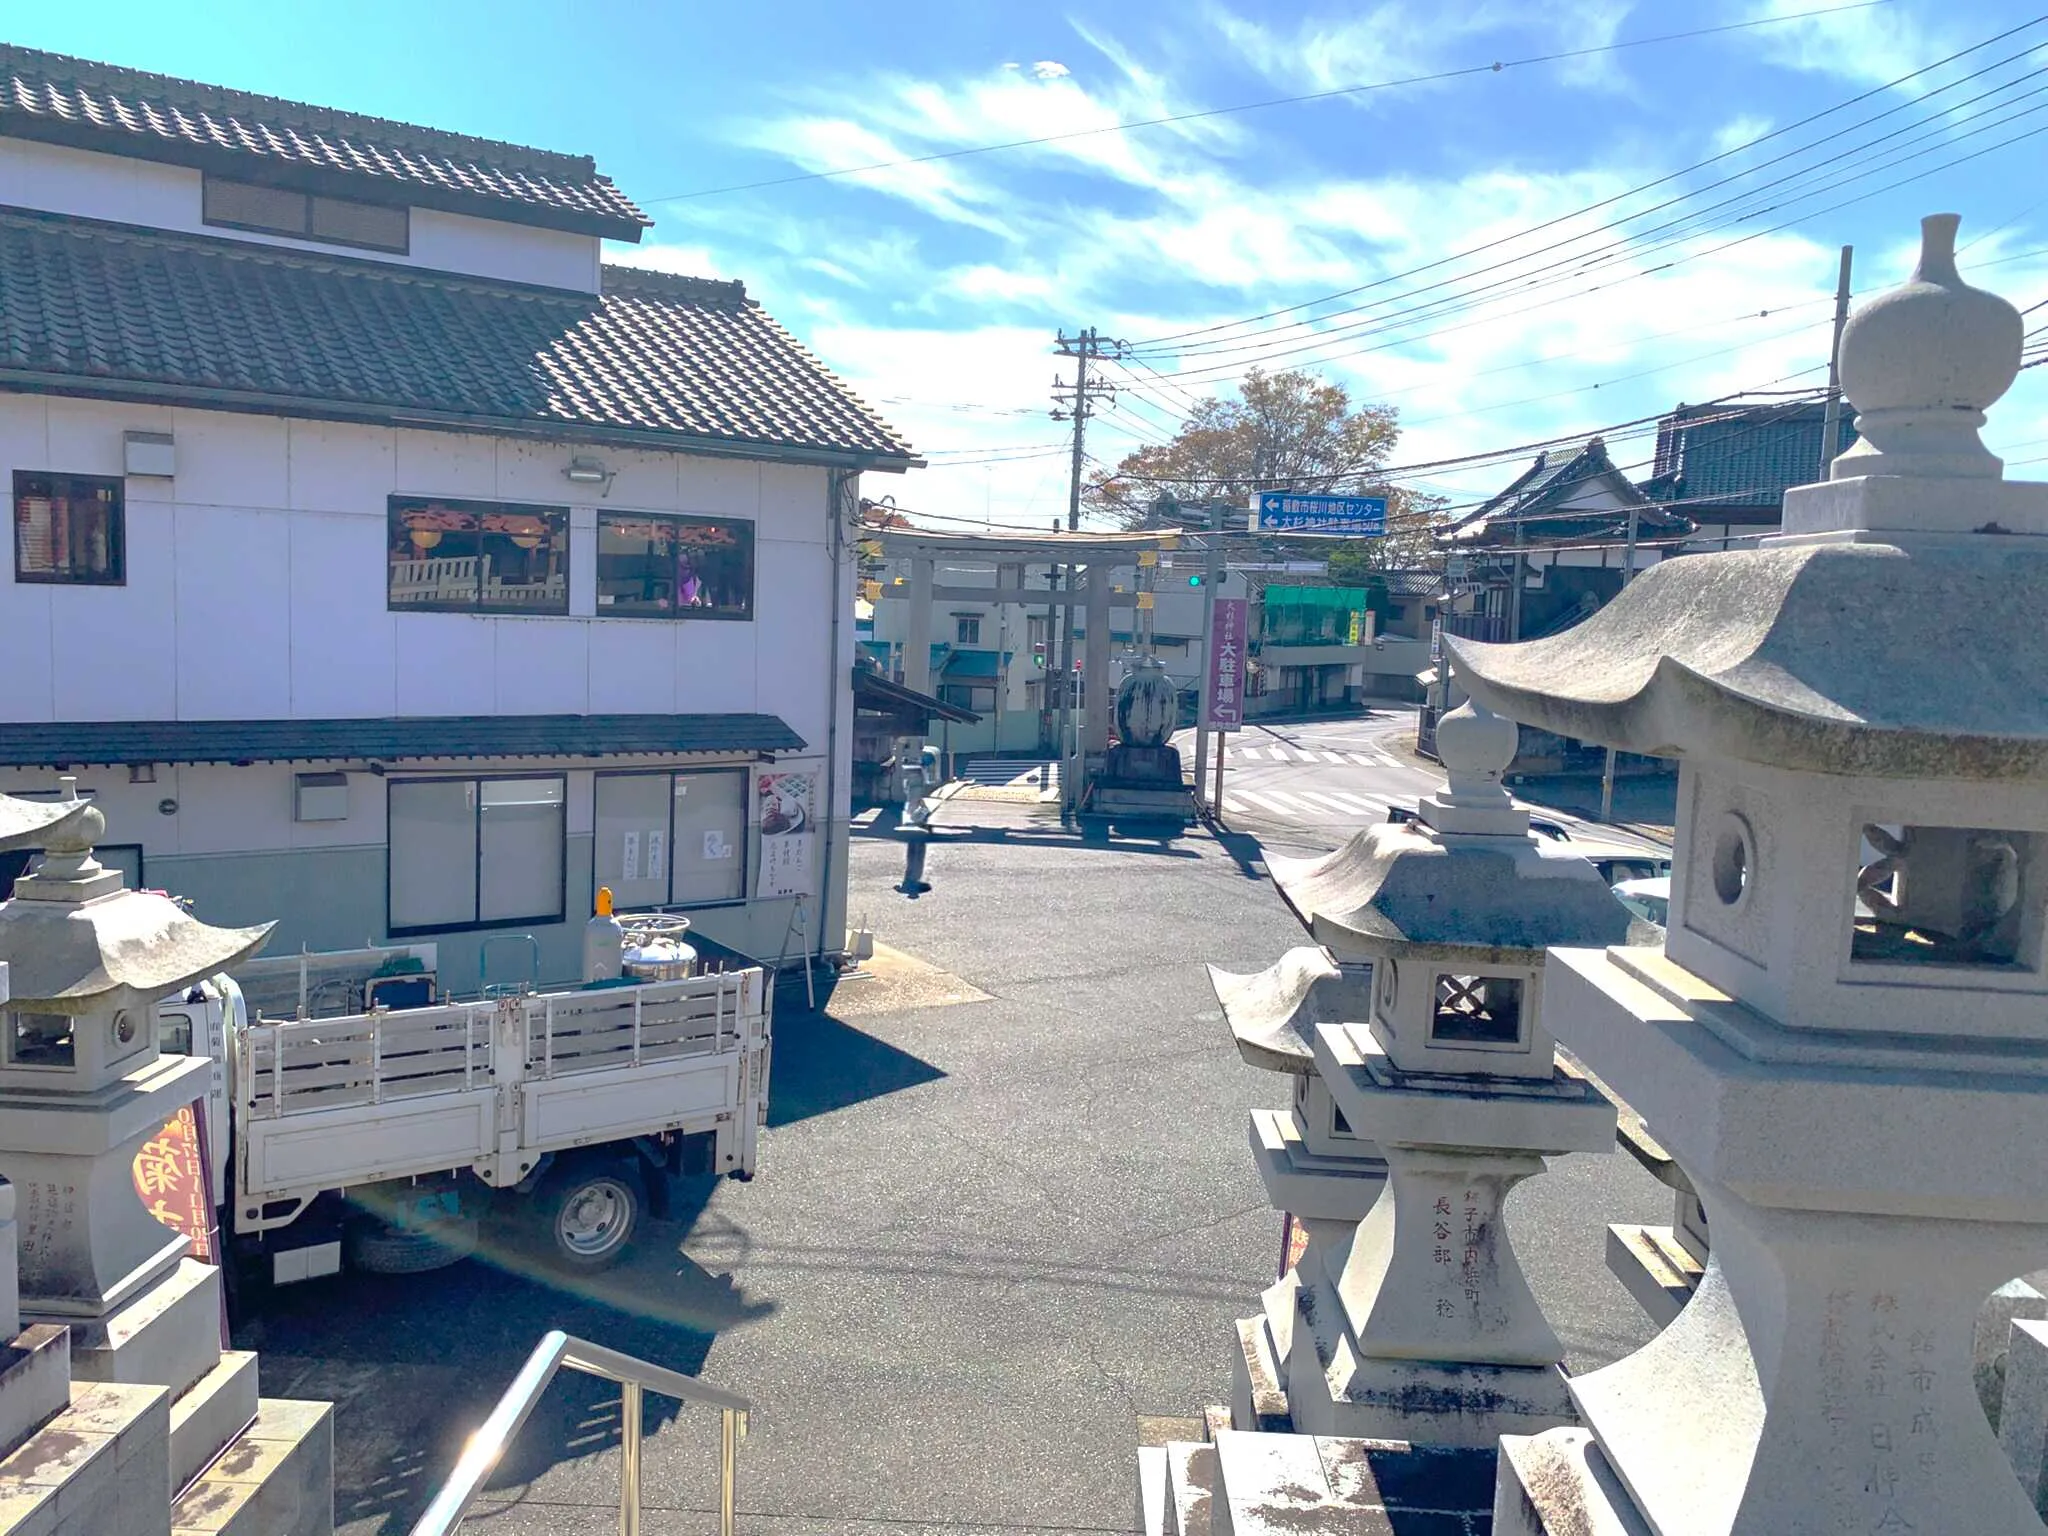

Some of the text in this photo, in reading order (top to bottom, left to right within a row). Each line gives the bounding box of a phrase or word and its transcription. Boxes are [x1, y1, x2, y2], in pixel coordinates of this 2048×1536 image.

[1215, 641, 1238, 704] 大駐車場
[1432, 1195, 1453, 1266] 長谷部
